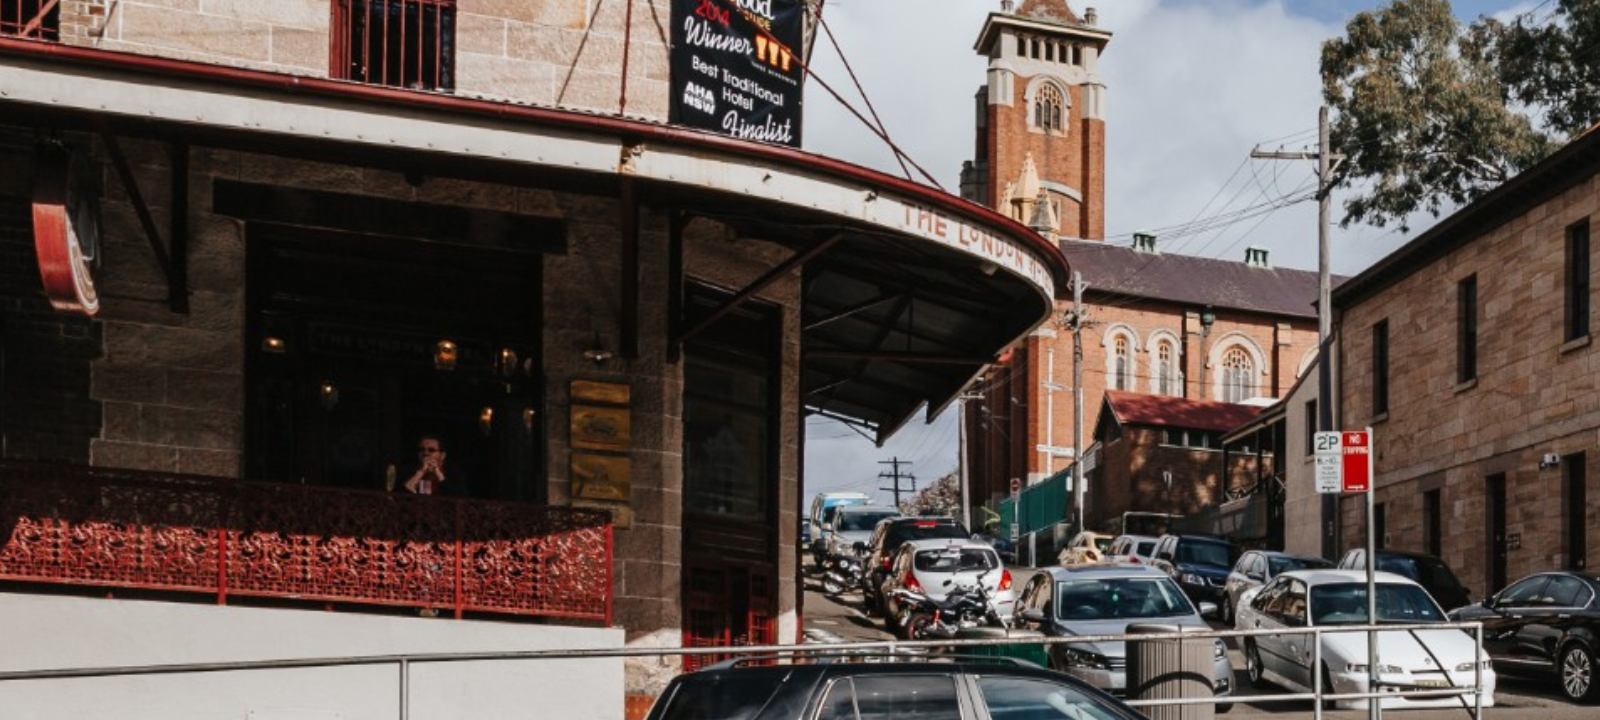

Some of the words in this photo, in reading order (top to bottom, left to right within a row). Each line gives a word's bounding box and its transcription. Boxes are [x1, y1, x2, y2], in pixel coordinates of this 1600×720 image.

[684, 15, 754, 55] Winner
[685, 81, 714, 102] AHA
[691, 54, 719, 79] Best
[722, 68, 785, 107] Traditional
[683, 93, 715, 115] NSW
[722, 86, 753, 112] Hotel
[722, 110, 793, 143] Finalist
[904, 203, 947, 238] THE
[957, 220, 1024, 269] LONDON
[1317, 435, 1339, 451] 2P
